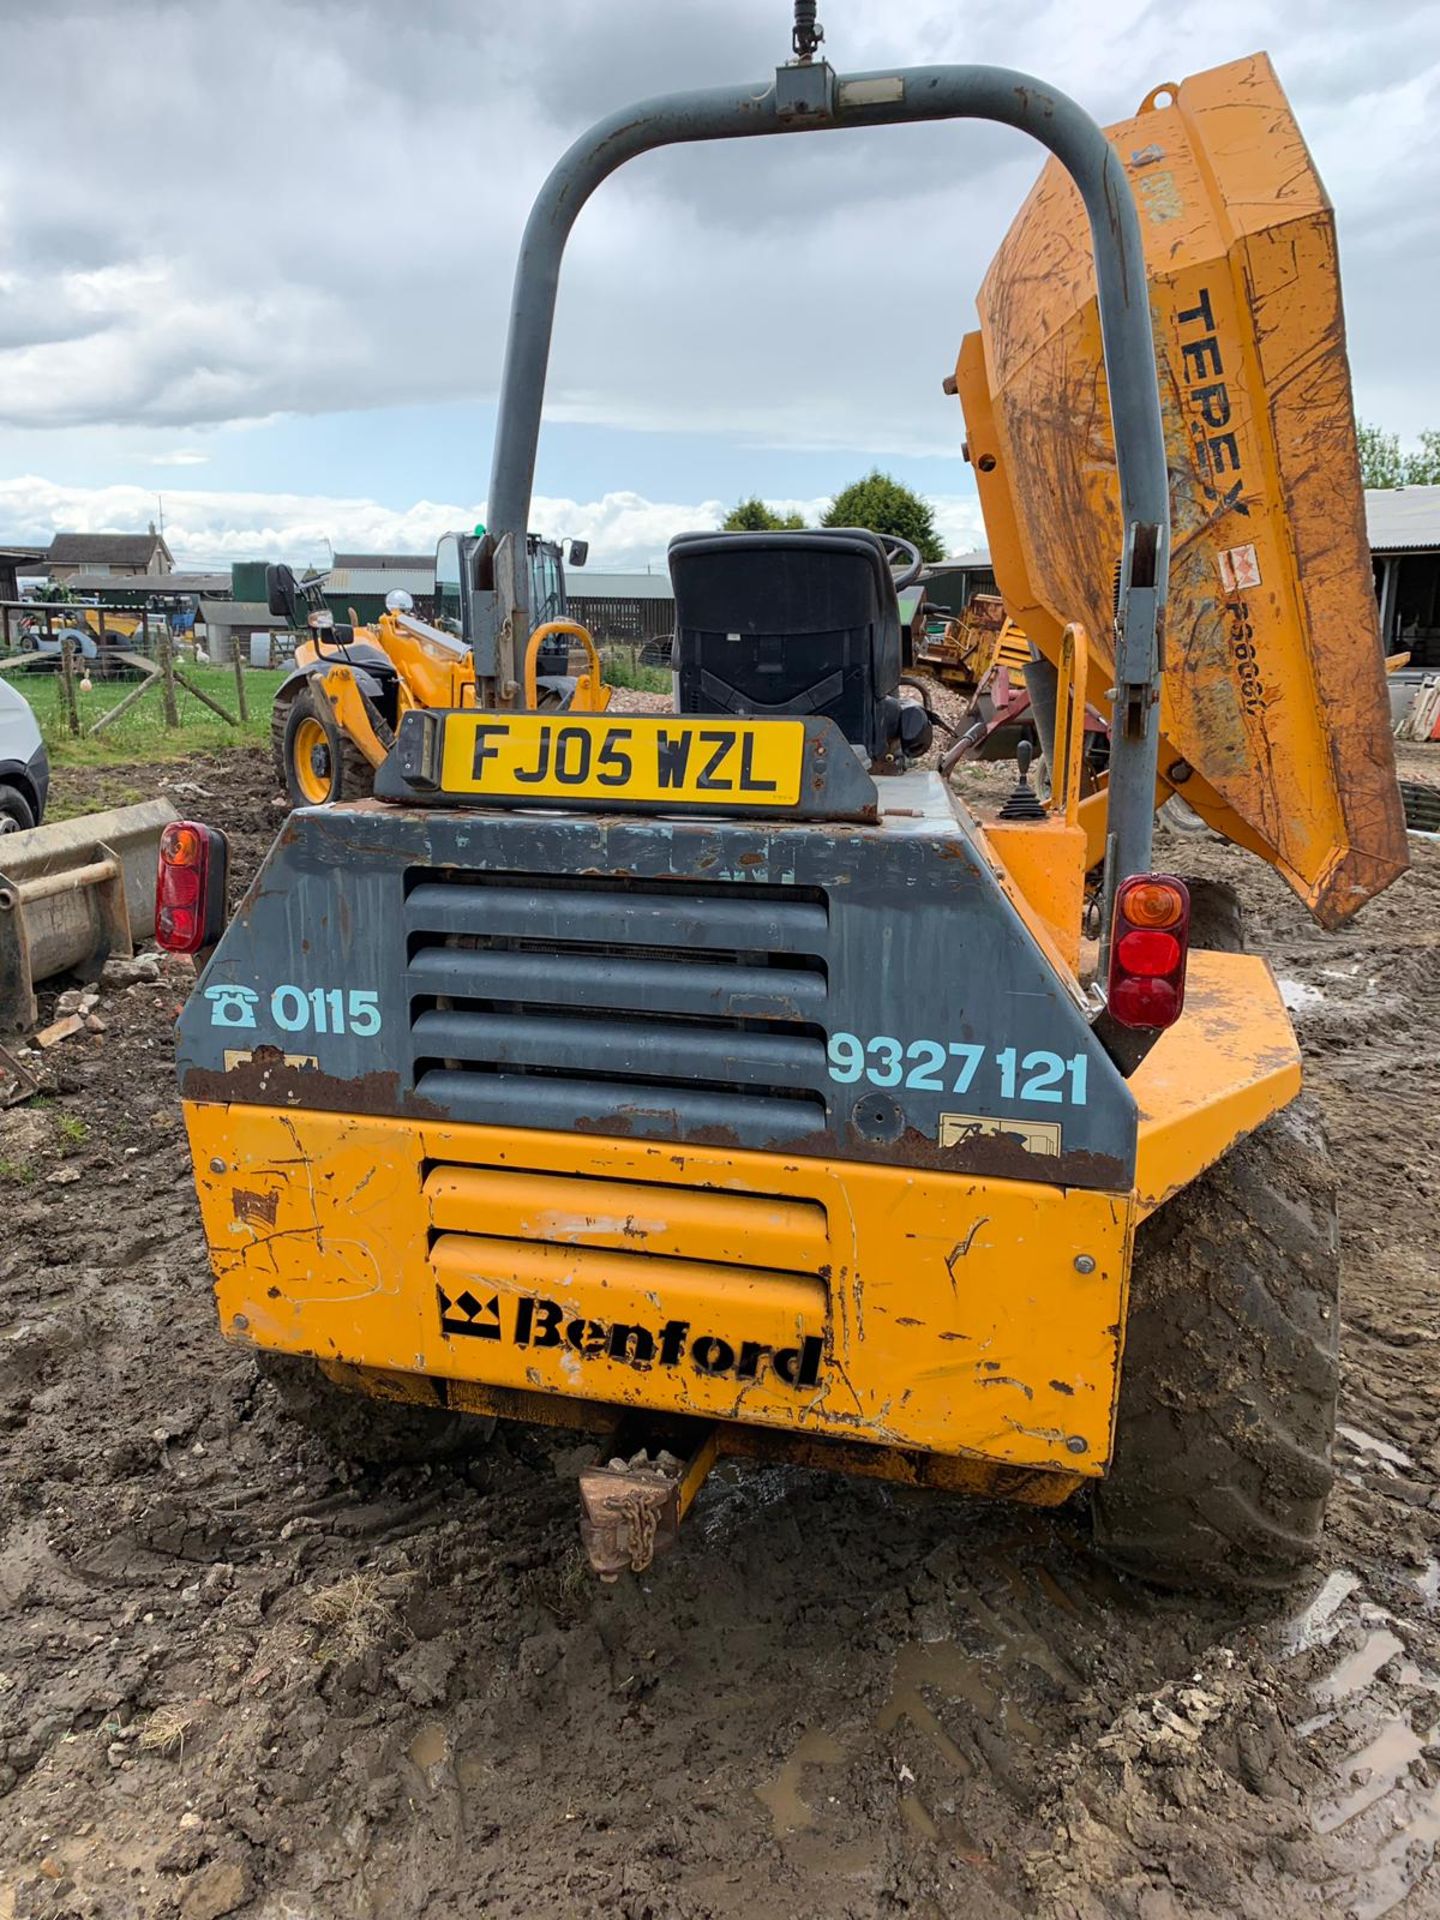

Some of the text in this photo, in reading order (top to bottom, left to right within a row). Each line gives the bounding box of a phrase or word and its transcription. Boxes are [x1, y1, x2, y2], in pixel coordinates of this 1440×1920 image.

[1178, 288, 1250, 518] TEREX
[471, 724, 777, 791] FJ05 WZL
[271, 985, 382, 1037] 0115
[827, 1032, 1088, 1105] 9327 121
[514, 1297, 824, 1387] Benford
